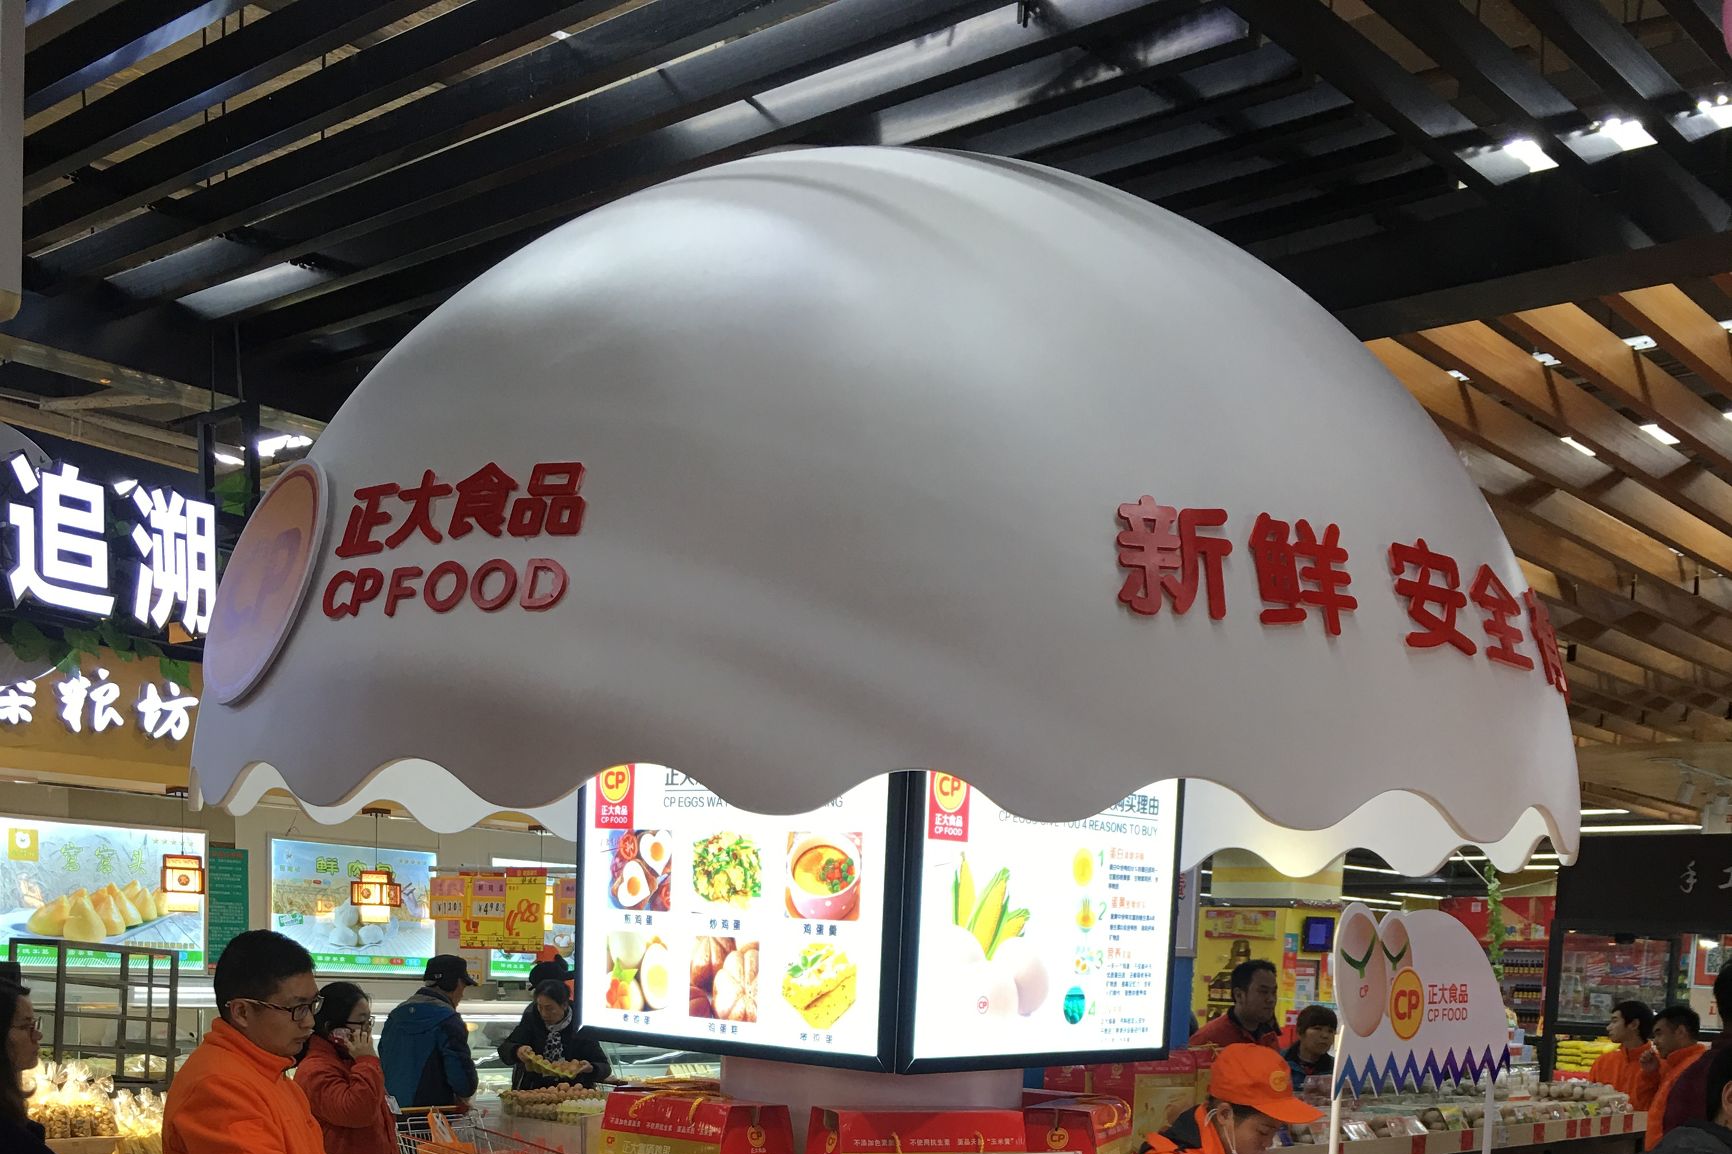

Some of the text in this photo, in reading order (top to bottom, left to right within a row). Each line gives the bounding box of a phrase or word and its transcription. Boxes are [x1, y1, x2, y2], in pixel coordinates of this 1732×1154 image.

[335, 461, 586, 558] 正大食品
[9, 453, 216, 636] 追溯
[1118, 495, 1358, 635] 新鲜
[605, 771, 626, 790] CP
[939, 776, 961, 797] CP
[601, 805, 628, 815] 正大食品
[664, 797, 676, 808] CP
[678, 797, 704, 808] EGGS
[1111, 794, 1160, 816] 购买理由
[601, 816, 628, 824] CP FOOD
[935, 813, 963, 827] 正大食品
[1088, 819, 1128, 834] REASONS
[1130, 824, 1140, 835] TO
[1142, 825, 1158, 837] BUY
[934, 826, 963, 836] CP FOOD
[1098, 901, 1107, 921] 2
[1359, 984, 1369, 998] CP
[1428, 984, 1469, 1005] 正大食品
[978, 1001, 988, 1009] CP
[1394, 989, 1420, 1021] CP
[1428, 1007, 1468, 1022] CP FOOD
[750, 1130, 763, 1140] CP
[1050, 1132, 1065, 1143] CP
